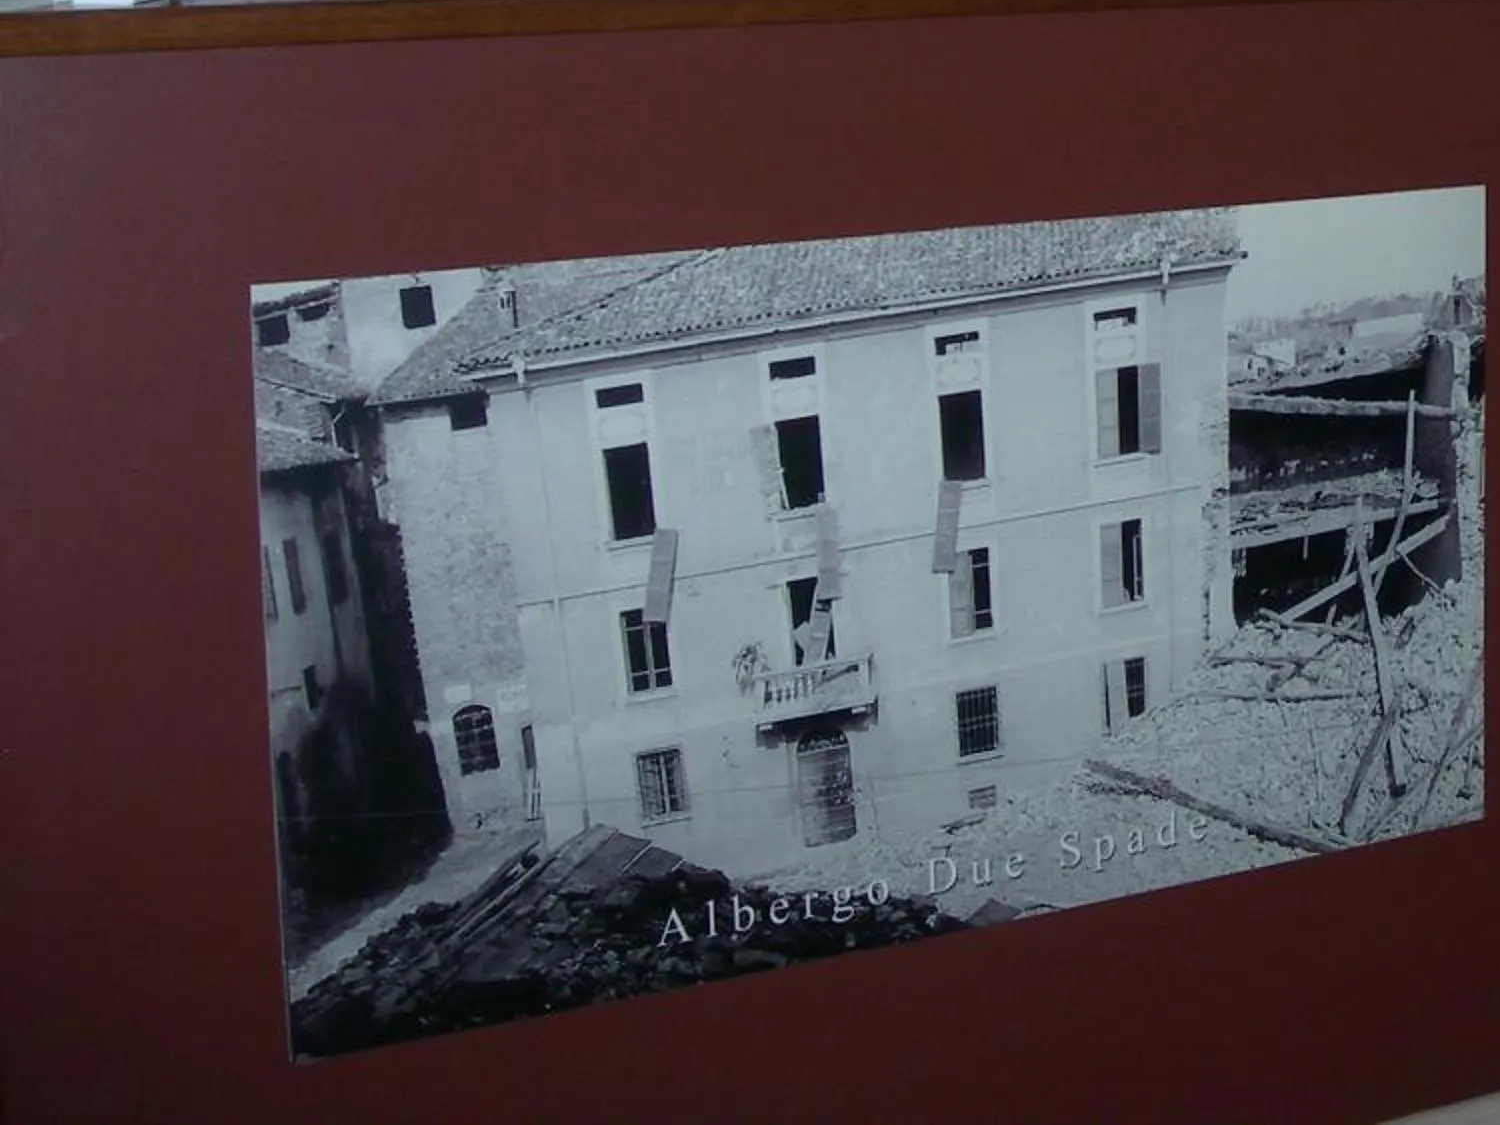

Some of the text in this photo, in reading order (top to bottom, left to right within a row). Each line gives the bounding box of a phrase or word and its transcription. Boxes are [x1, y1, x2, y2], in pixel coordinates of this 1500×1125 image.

[656, 812, 1212, 949] Albergo Due Spade
